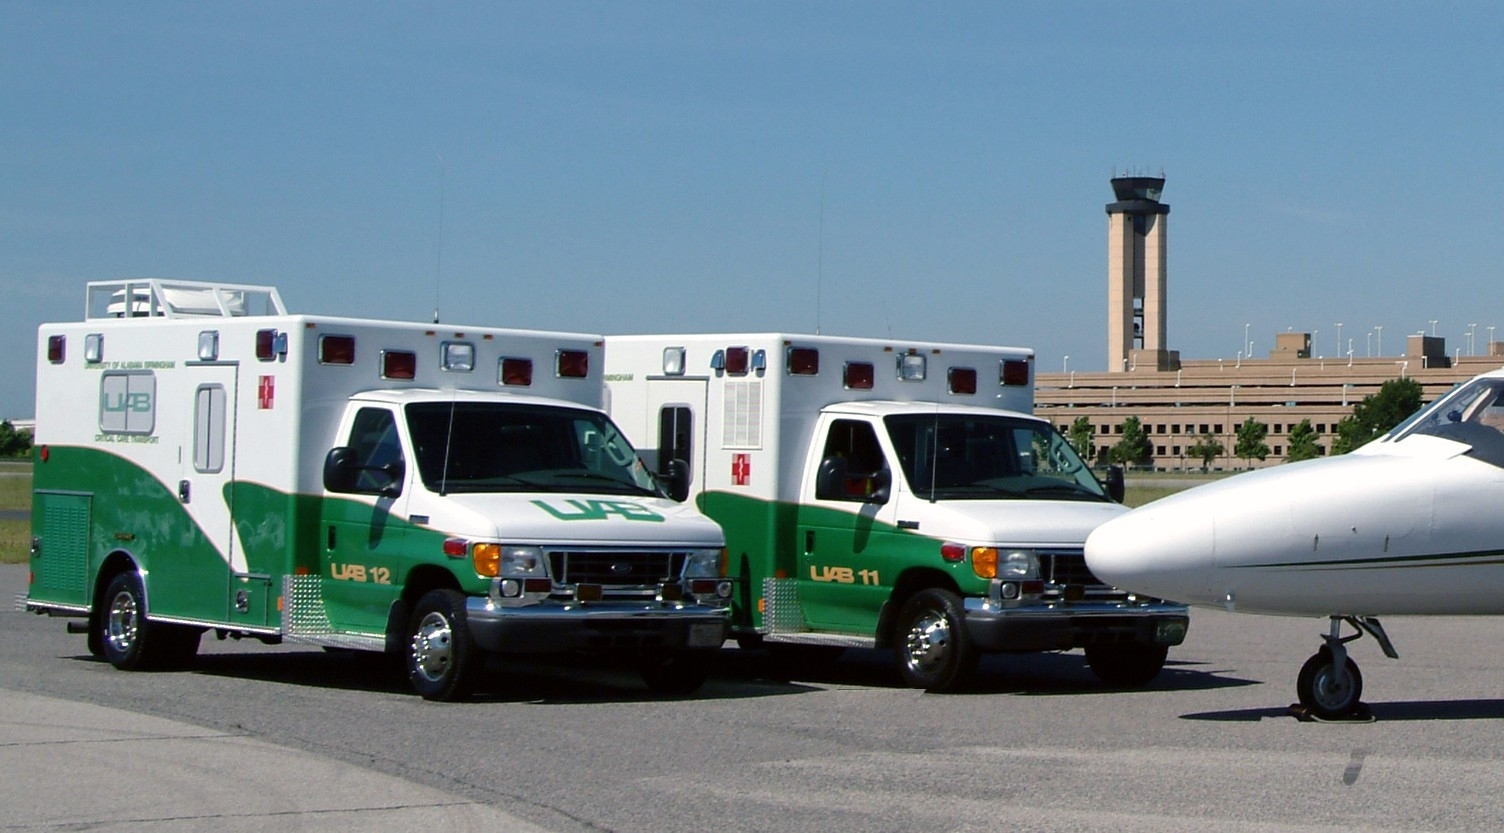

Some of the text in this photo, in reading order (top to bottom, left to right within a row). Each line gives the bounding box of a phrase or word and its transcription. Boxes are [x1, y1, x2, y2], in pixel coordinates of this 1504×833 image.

[104, 392, 152, 412] UAB
[529, 499, 665, 522] UAB
[331, 562, 391, 585] UAB 12
[810, 565, 879, 586] UAB 11
